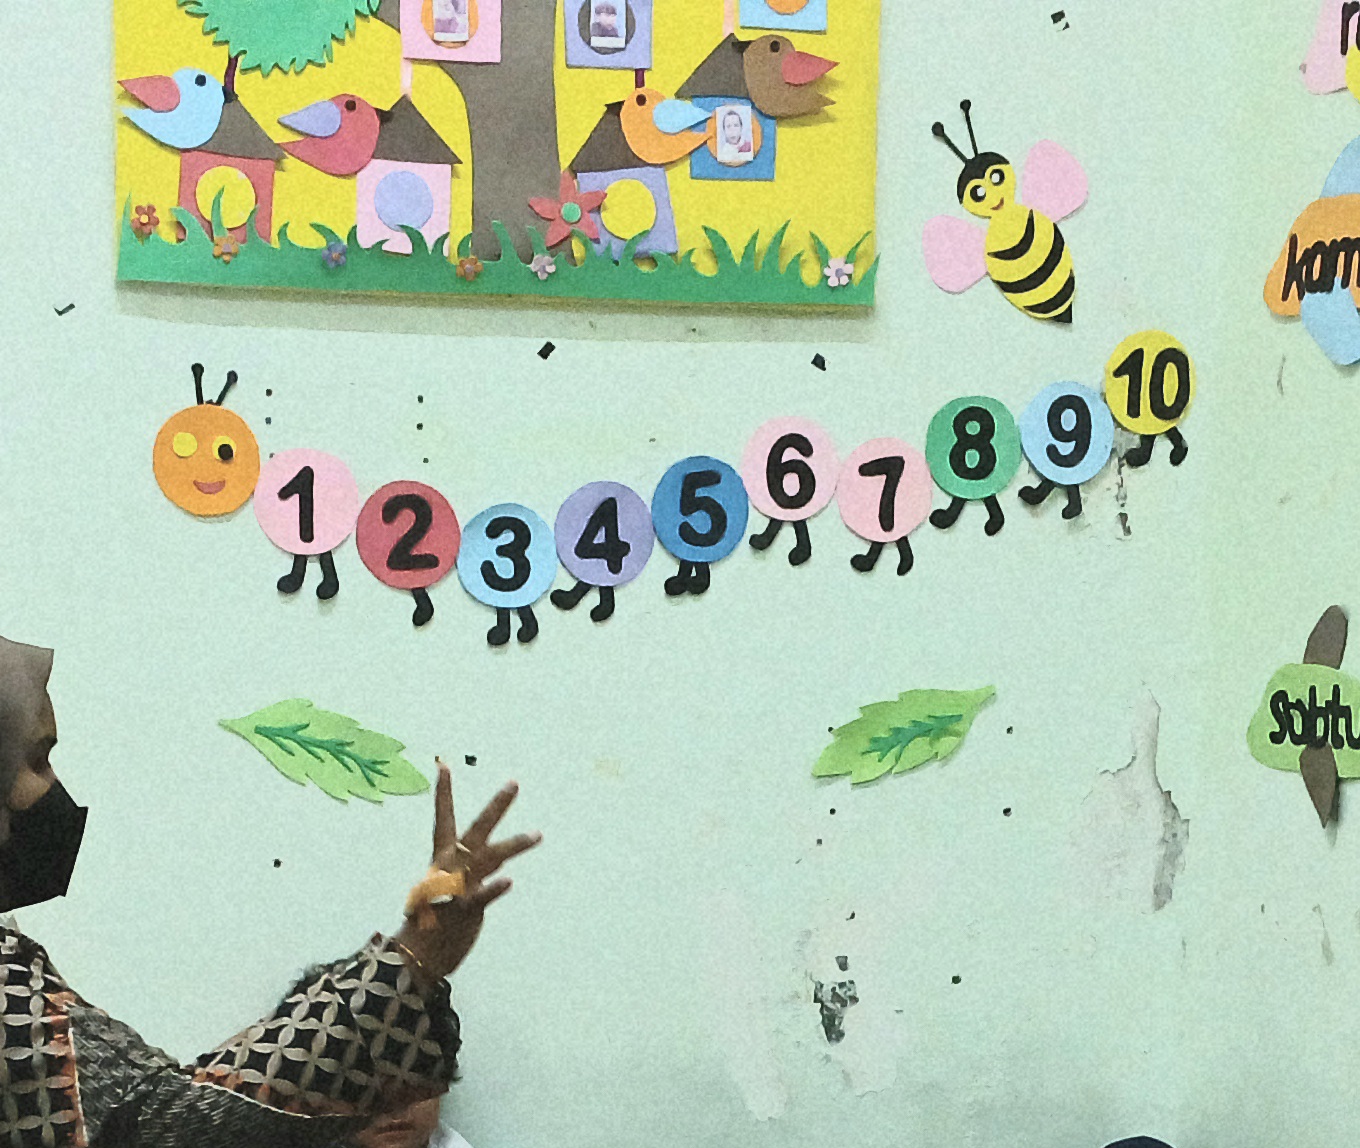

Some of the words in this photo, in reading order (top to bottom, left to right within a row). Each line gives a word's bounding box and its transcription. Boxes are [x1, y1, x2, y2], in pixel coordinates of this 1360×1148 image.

[279, 465, 315, 542] 1
[382, 493, 439, 571] 2
[480, 516, 532, 592] 3
[574, 497, 631, 575] 4
[678, 470, 727, 547] 5
[765, 432, 816, 510] 6
[858, 456, 906, 533] 7
[949, 405, 997, 481] 8
[1045, 394, 1092, 468] 9
[1112, 347, 1191, 421] 10
